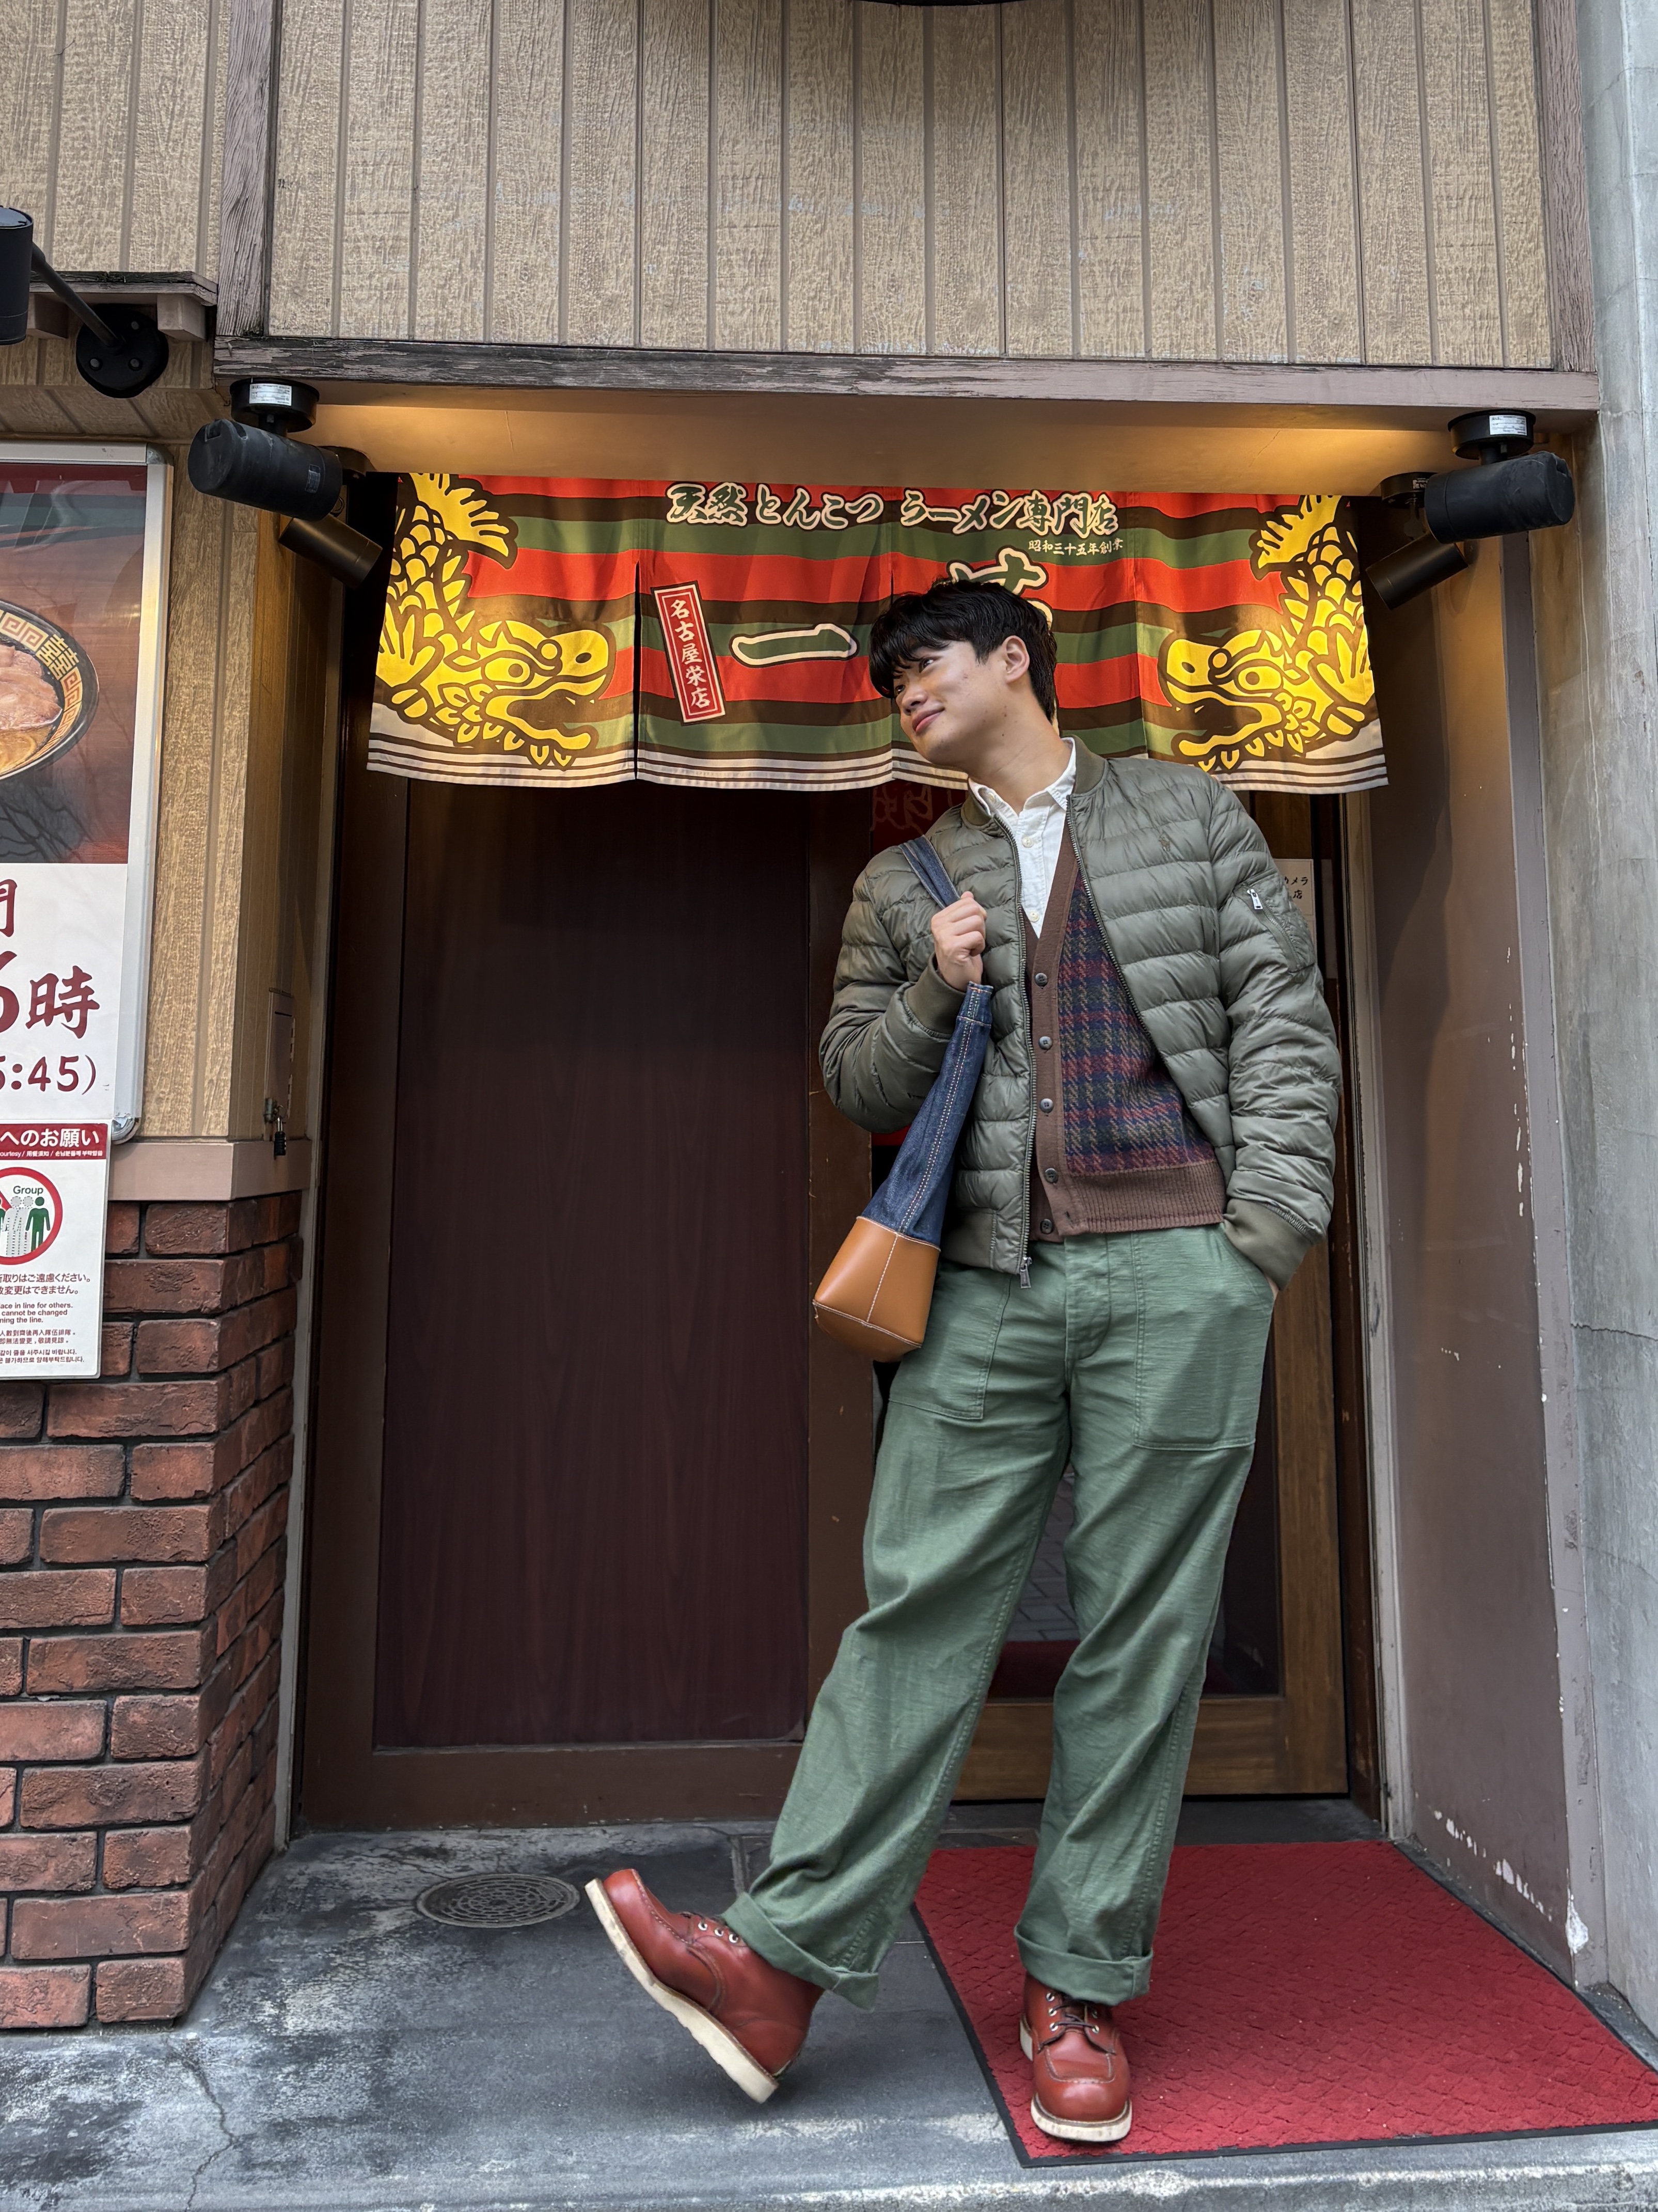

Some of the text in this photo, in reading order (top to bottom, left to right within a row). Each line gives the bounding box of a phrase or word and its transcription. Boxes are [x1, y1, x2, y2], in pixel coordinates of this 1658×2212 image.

[670, 599, 710, 708] 名古屋栄店
[0, 1054, 96, 1095] :45)
[13, 1186, 43, 1196] Group
